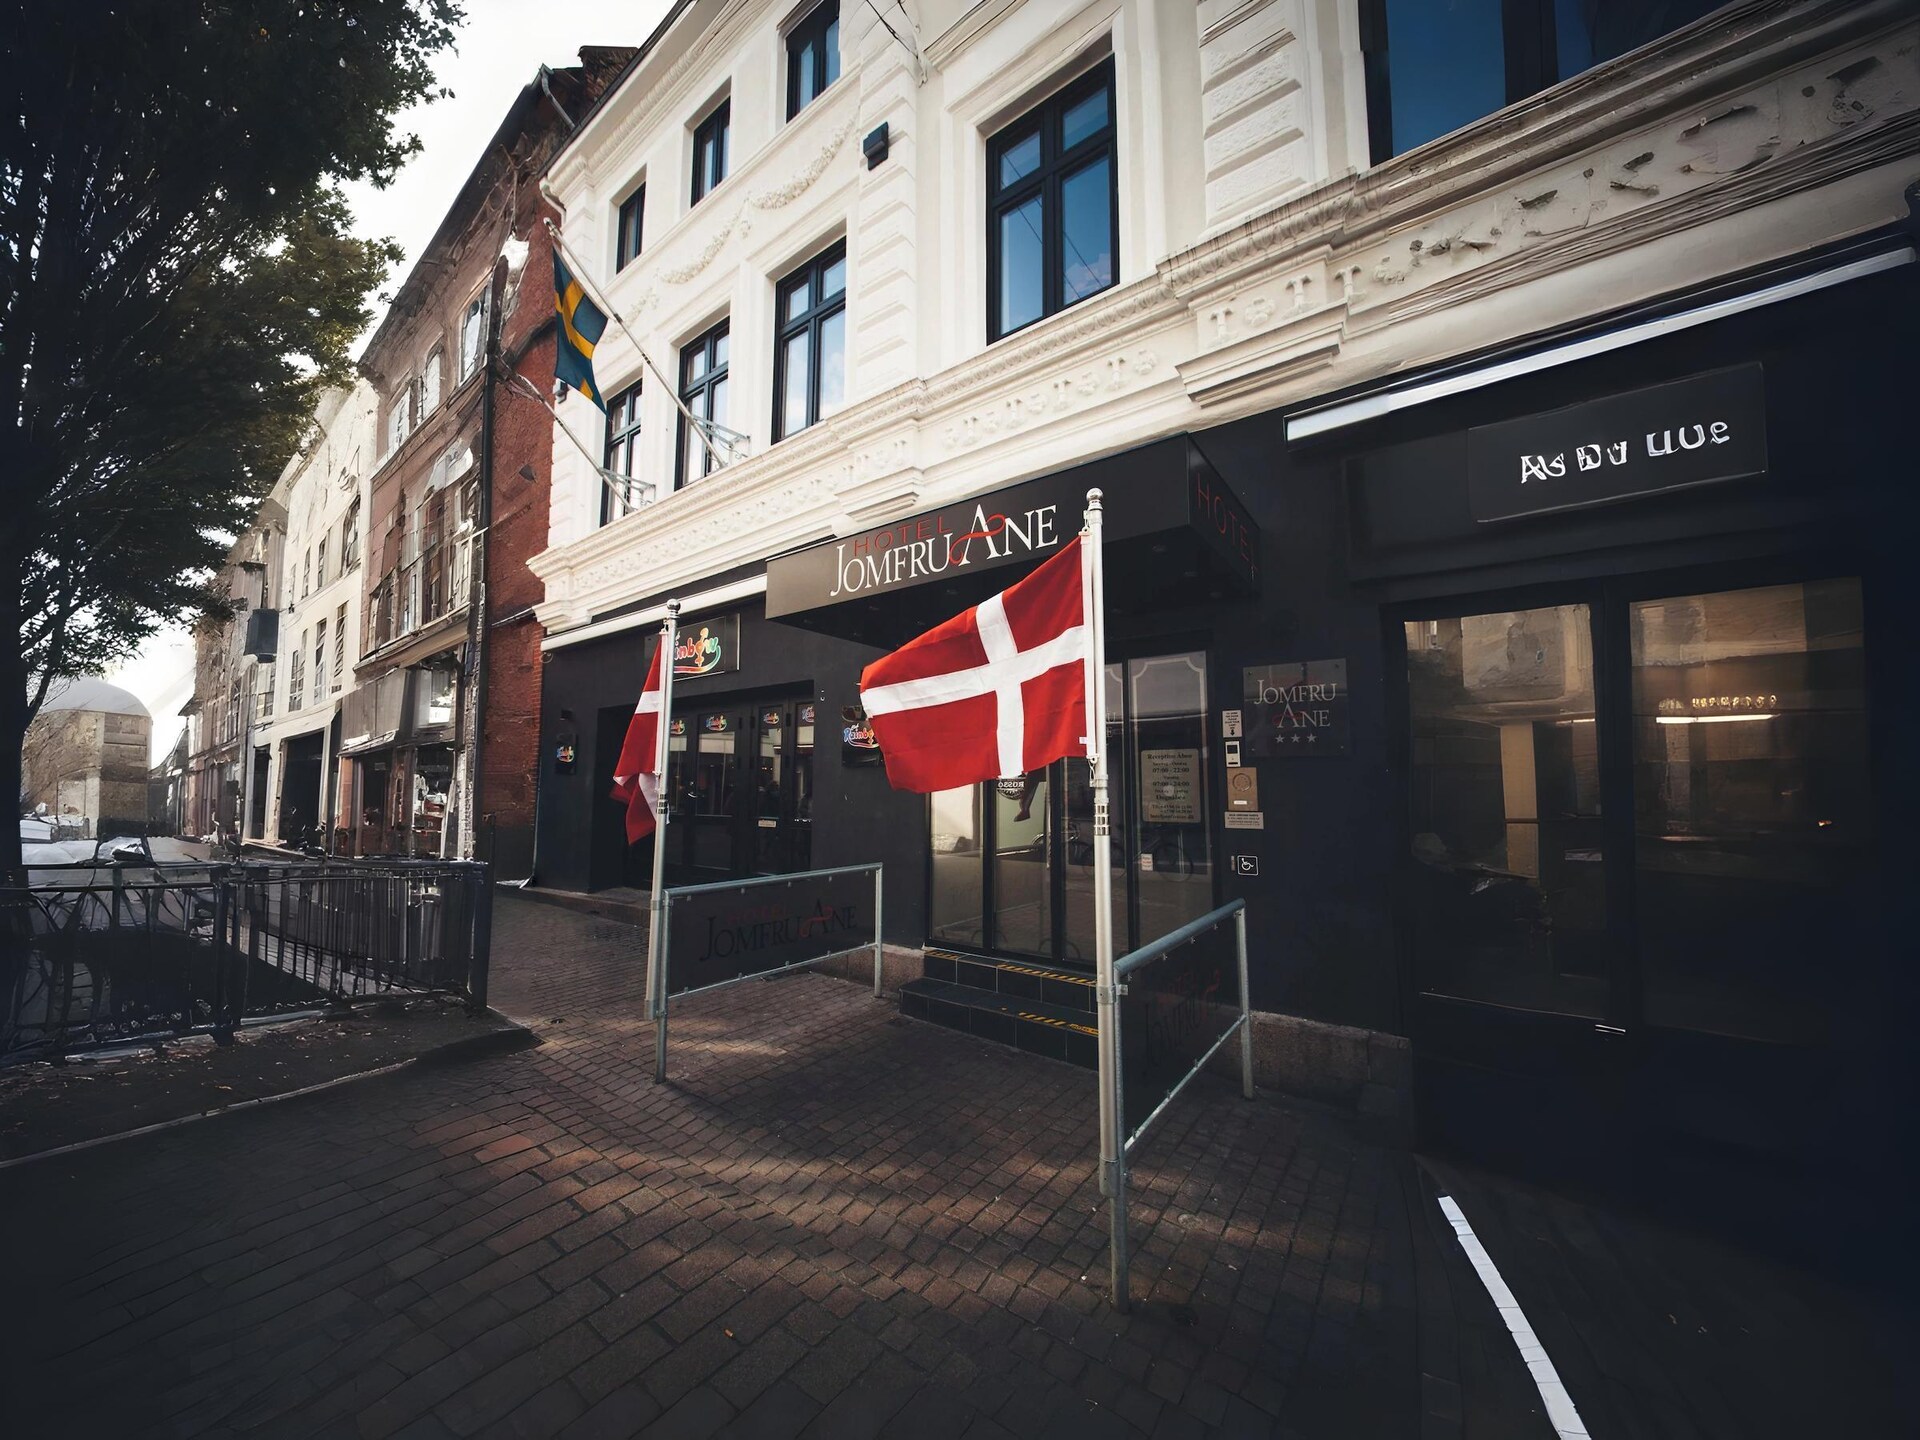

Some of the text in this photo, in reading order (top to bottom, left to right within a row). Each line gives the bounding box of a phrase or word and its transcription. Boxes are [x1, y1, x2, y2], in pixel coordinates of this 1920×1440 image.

[830, 503, 1059, 597] JOMFRU ANE
[853, 515, 950, 556] HOTEL
[1254, 679, 1337, 705] JOMFRU
[1277, 701, 1331, 729] ANE
[699, 898, 858, 962] JOMFRU ANE
